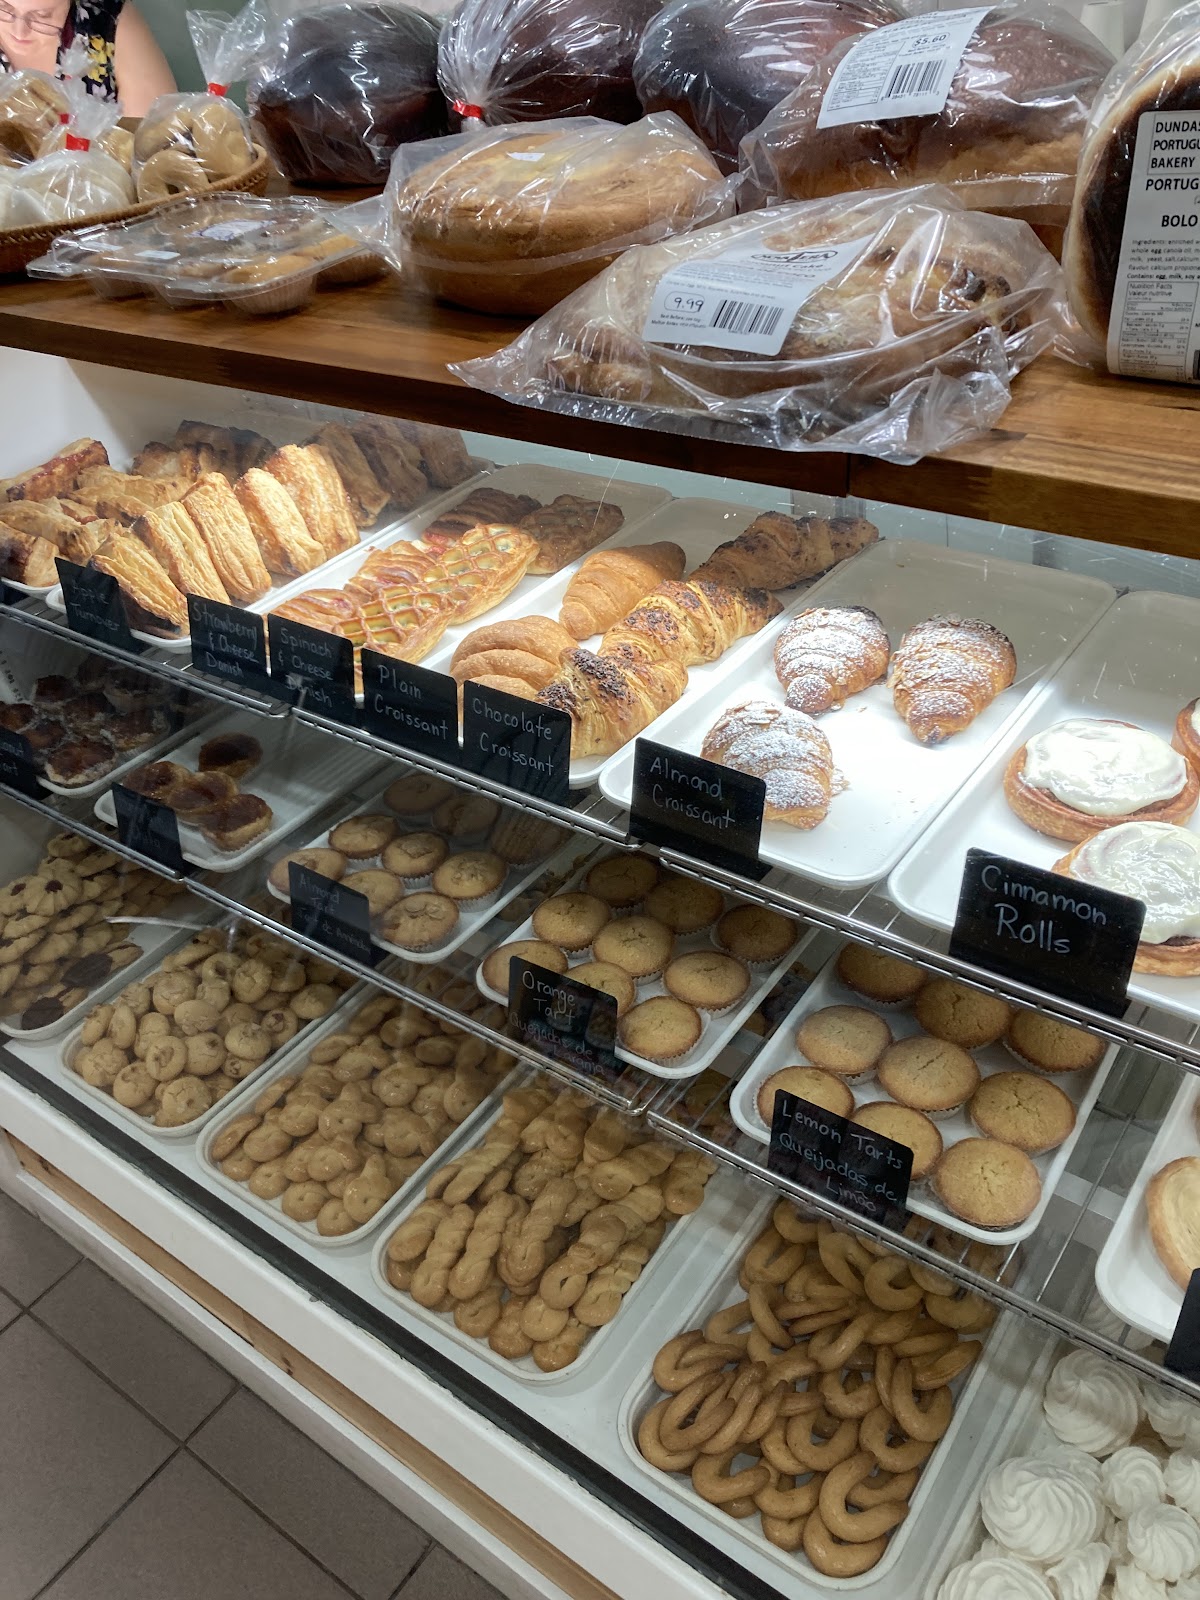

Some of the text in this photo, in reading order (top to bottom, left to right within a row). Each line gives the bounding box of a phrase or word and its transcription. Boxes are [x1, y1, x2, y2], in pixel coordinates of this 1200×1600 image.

[914, 34, 947, 47] $5.60
[1151, 157, 1195, 169] BAKERY
[1146, 178, 1199, 191] PORTUG
[1162, 215, 1198, 227] BOLO
[674, 297, 705, 312] 9.99
[192, 601, 258, 651] Strawberry
[280, 626, 333, 659] Spinach
[205, 651, 244, 678] Danish
[220, 633, 260, 664] Cheese
[292, 655, 334, 681] Cheese
[377, 663, 423, 701] Plain
[285, 674, 333, 708] Danish
[372, 693, 449, 740] Croissant
[471, 697, 553, 741] Chocolate
[478, 731, 555, 777] Croissant
[650, 756, 724, 801] Almond
[652, 783, 736, 829] Croissant
[981, 864, 1108, 926] Cinnamon
[994, 902, 1072, 954] Rolls
[522, 970, 576, 1015] Orange
[532, 997, 576, 1026] Tart
[554, 1043, 605, 1076] Laranja
[576, 1040, 593, 1061] de
[782, 1099, 903, 1170] Lemon Tarts
[779, 1132, 897, 1202] Queijadas de
[825, 1175, 877, 1212] Limão
